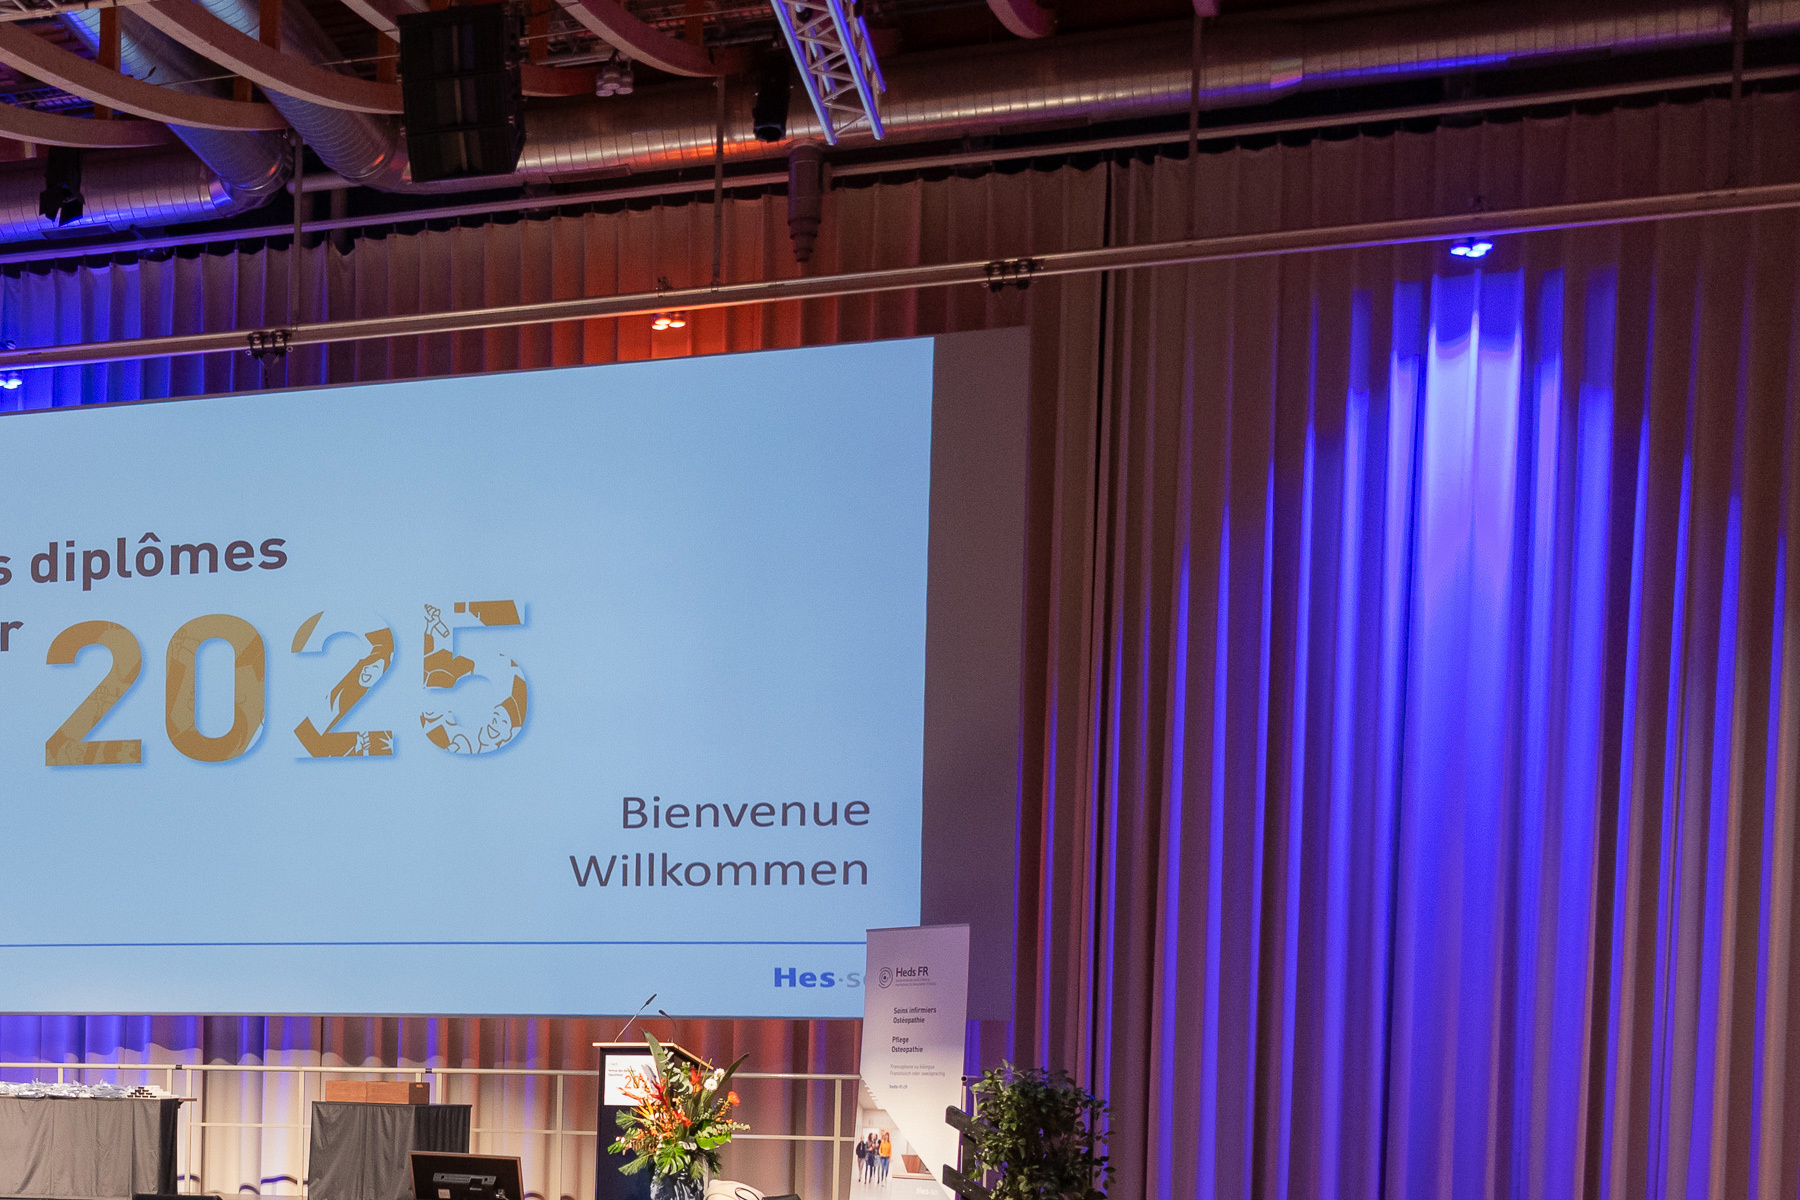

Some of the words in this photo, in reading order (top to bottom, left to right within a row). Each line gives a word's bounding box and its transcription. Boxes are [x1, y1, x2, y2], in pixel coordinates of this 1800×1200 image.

[30, 532, 289, 592] diplômes
[45, 599, 530, 767] 2025
[622, 796, 871, 829] Bienvenue
[569, 852, 869, 888] Willkommen
[895, 966, 916, 977] Heds
[917, 966, 929, 976] FR
[891, 1036, 909, 1044] Pflege
[891, 1046, 923, 1054] Osteopathie
